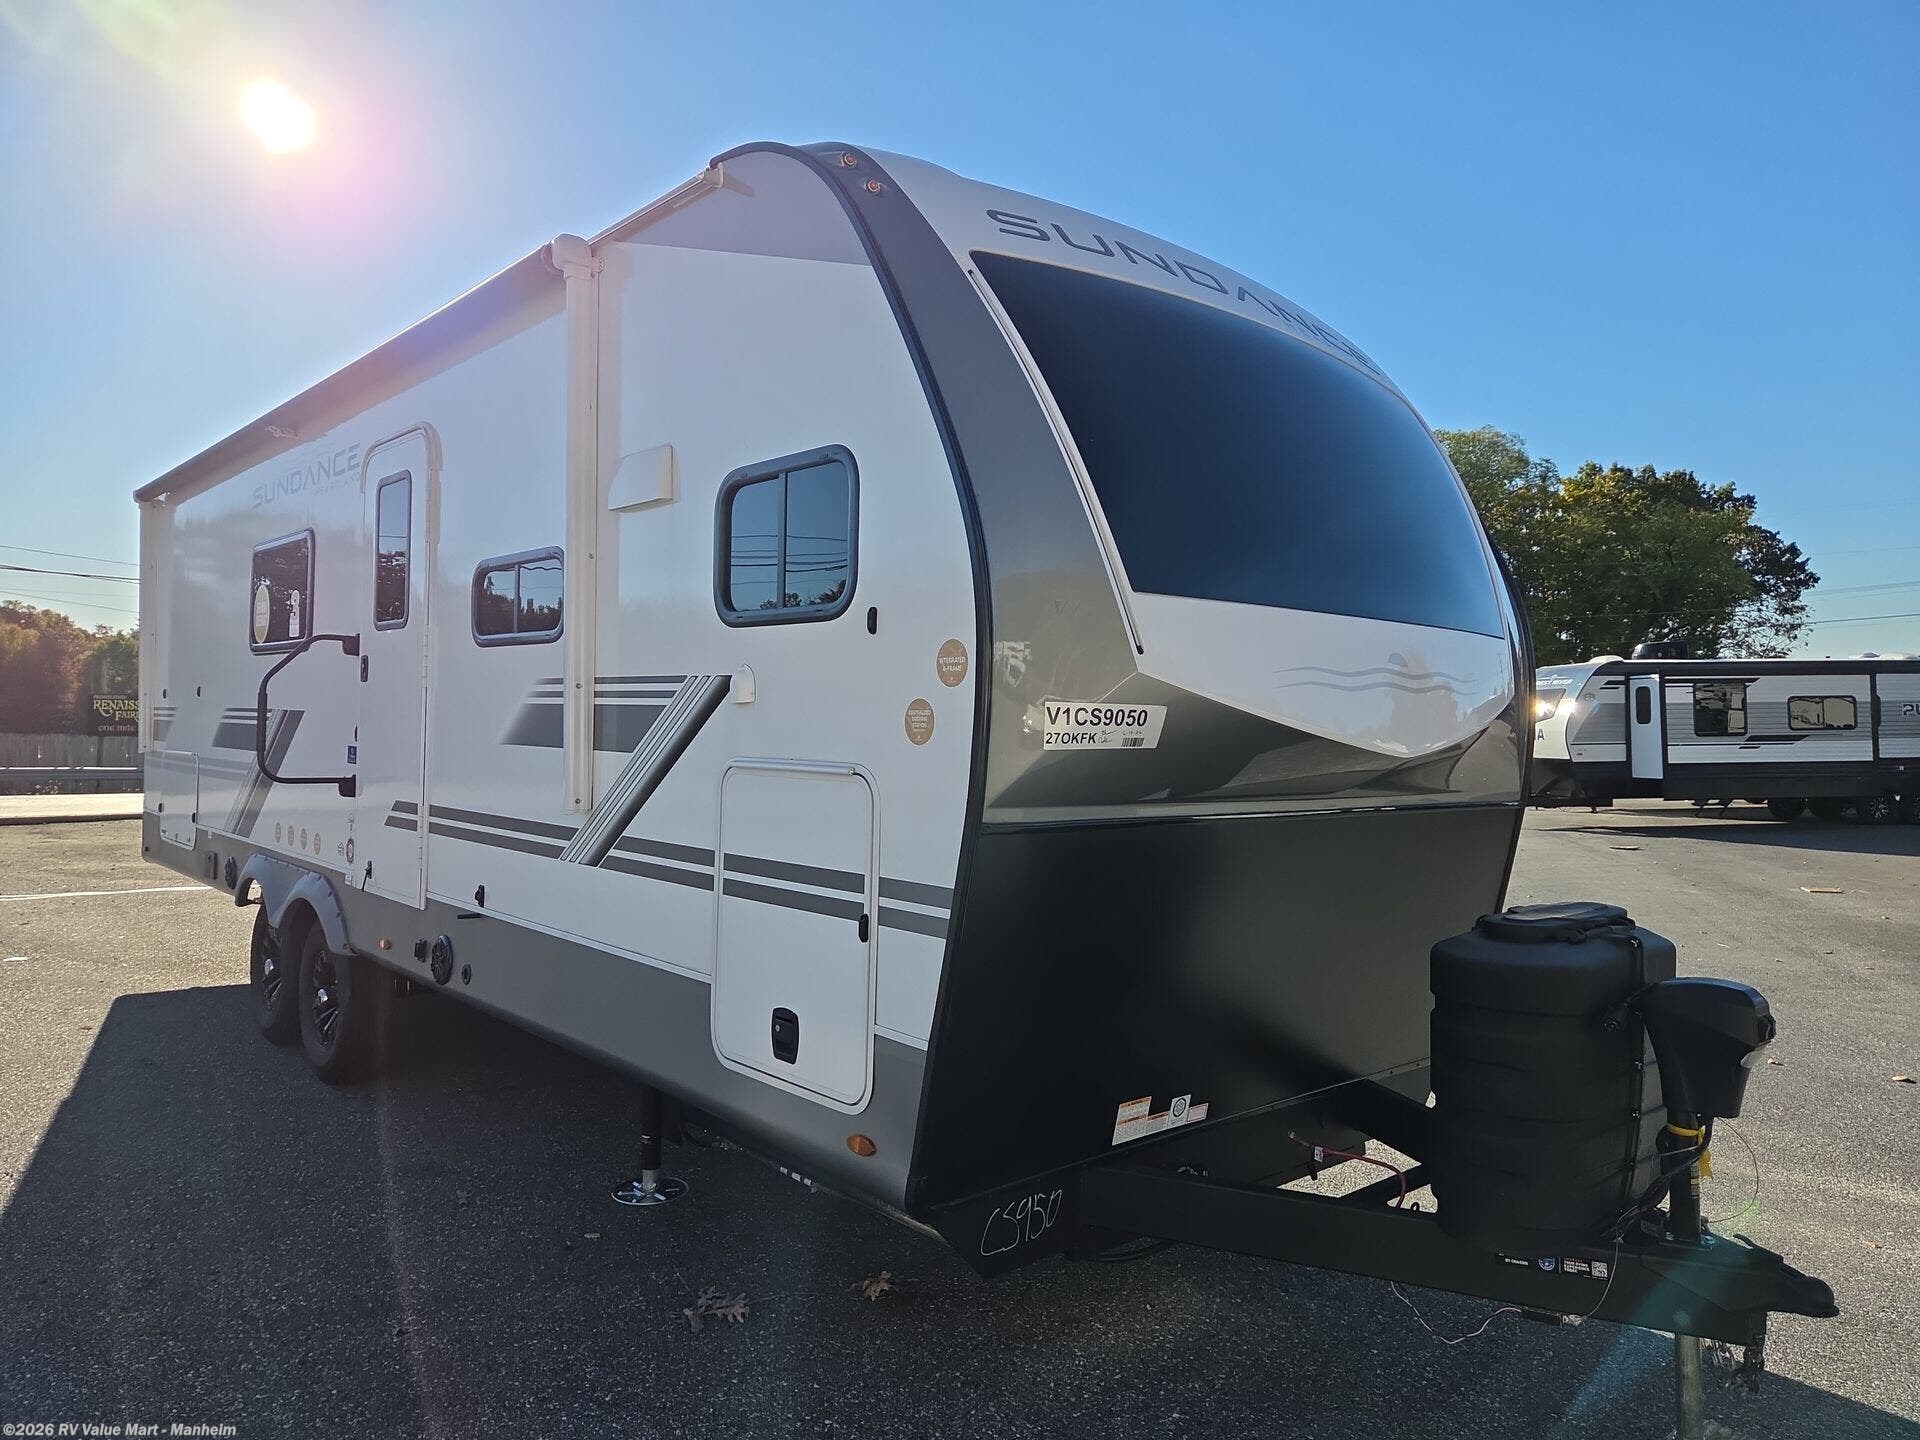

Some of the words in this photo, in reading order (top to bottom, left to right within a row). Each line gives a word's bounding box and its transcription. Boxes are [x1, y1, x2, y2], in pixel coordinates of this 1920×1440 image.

[986, 209, 1381, 376] SUNDANCE
[252, 440, 361, 510] SUNDANCE
[1046, 706, 1148, 727] V1CS9050
